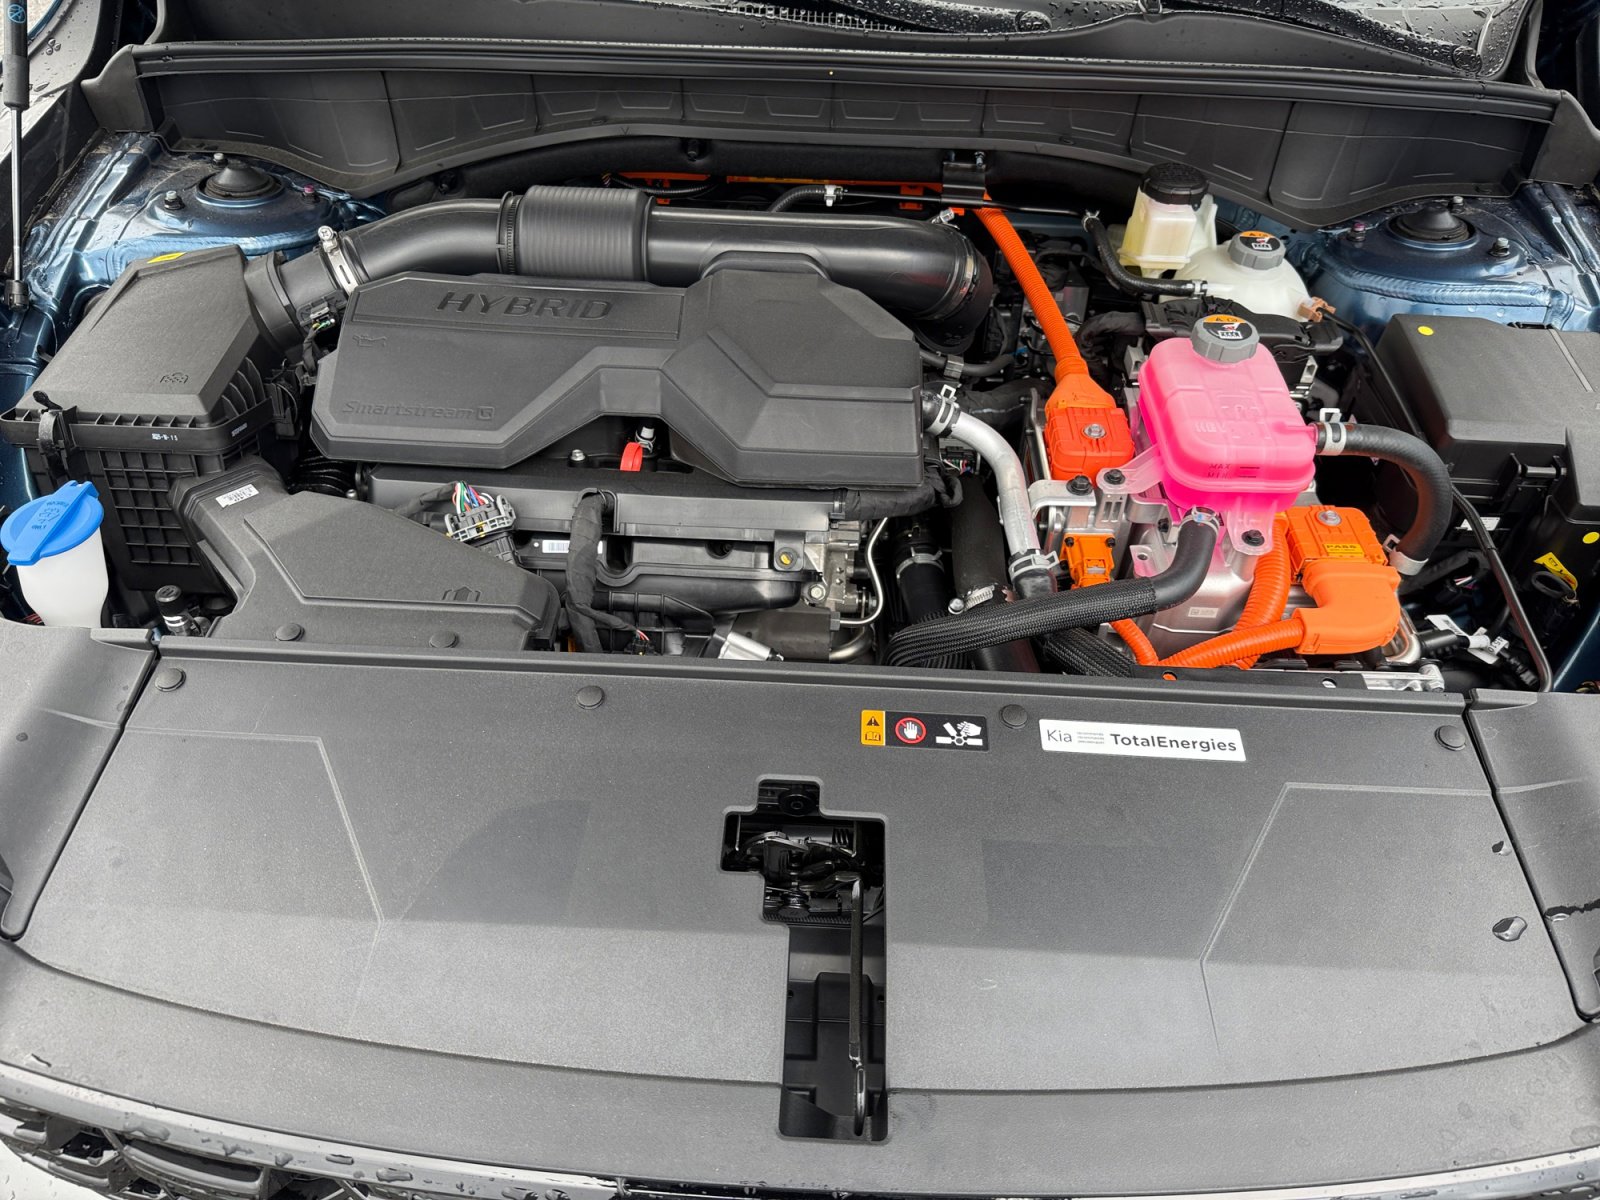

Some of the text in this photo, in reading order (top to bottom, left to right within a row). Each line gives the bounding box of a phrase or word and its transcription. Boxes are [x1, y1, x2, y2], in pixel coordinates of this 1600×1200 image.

[435, 290, 613, 320] HYBRID
[342, 401, 474, 420] Smartstream
[1047, 729, 1073, 743] Kia
[1110, 733, 1237, 752] TotalEnergies
